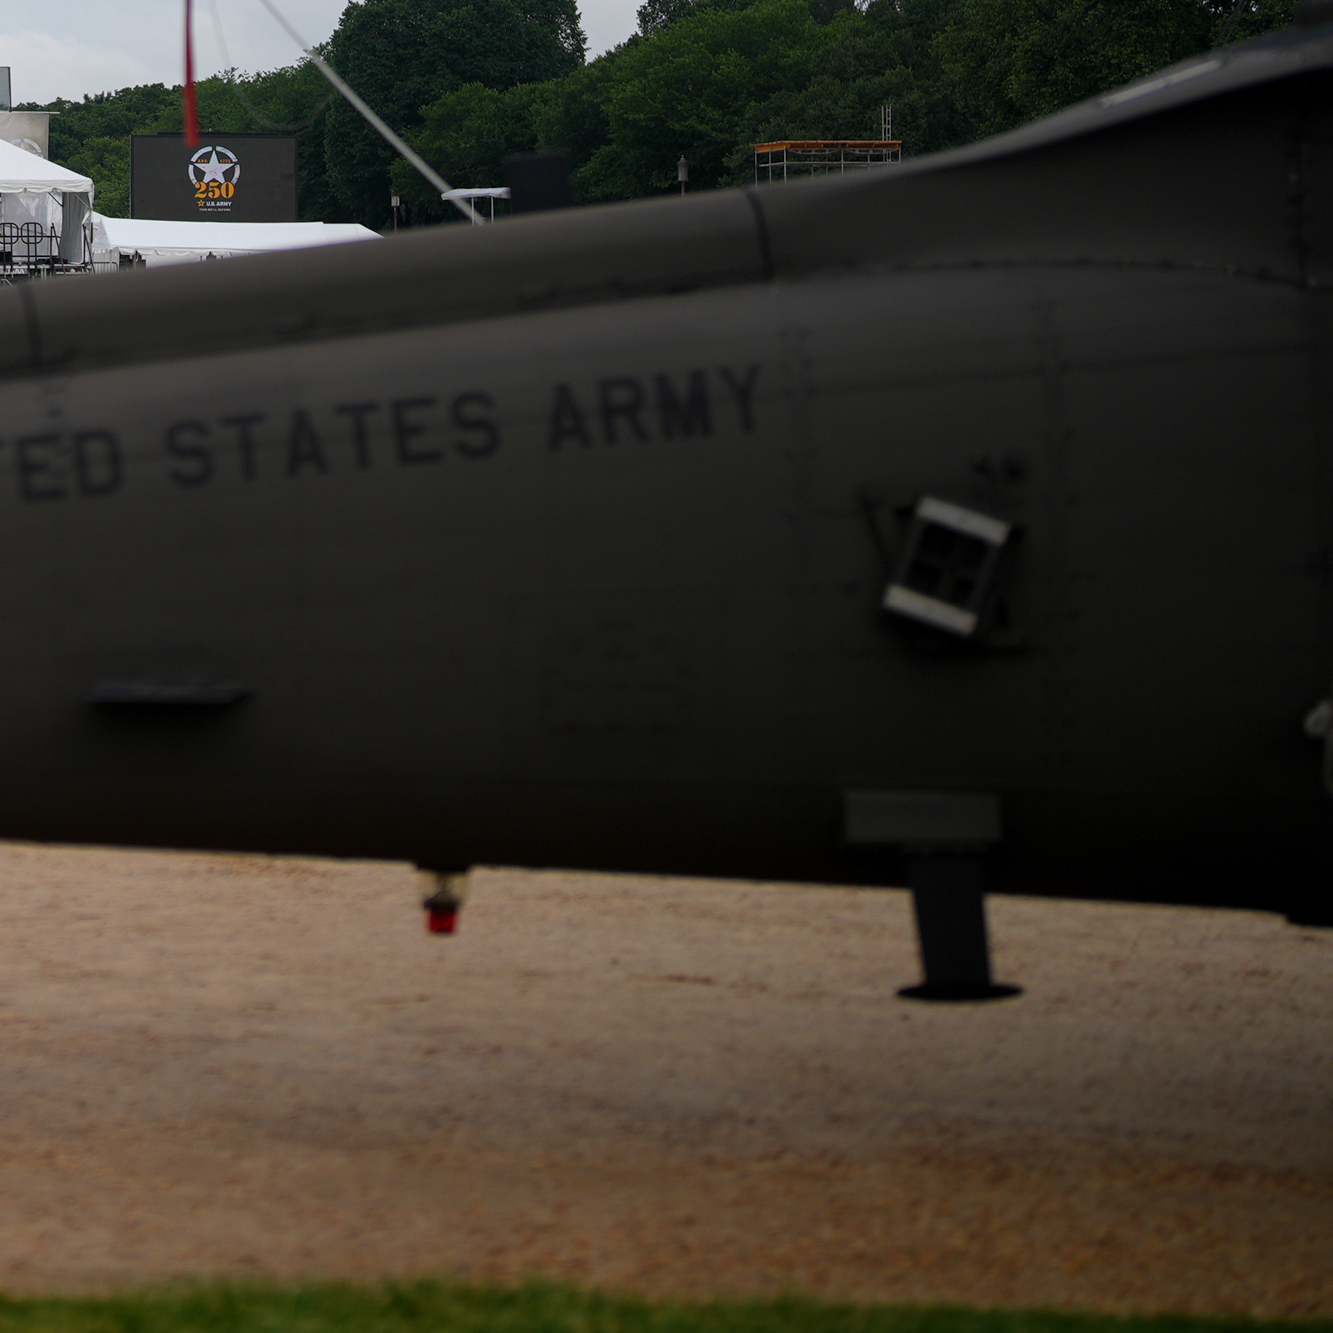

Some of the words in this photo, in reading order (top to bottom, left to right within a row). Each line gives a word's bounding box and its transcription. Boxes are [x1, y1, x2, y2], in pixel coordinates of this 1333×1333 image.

[194, 181, 235, 199] 250
[167, 390, 501, 490] STATES
[545, 363, 763, 454] ARMY
